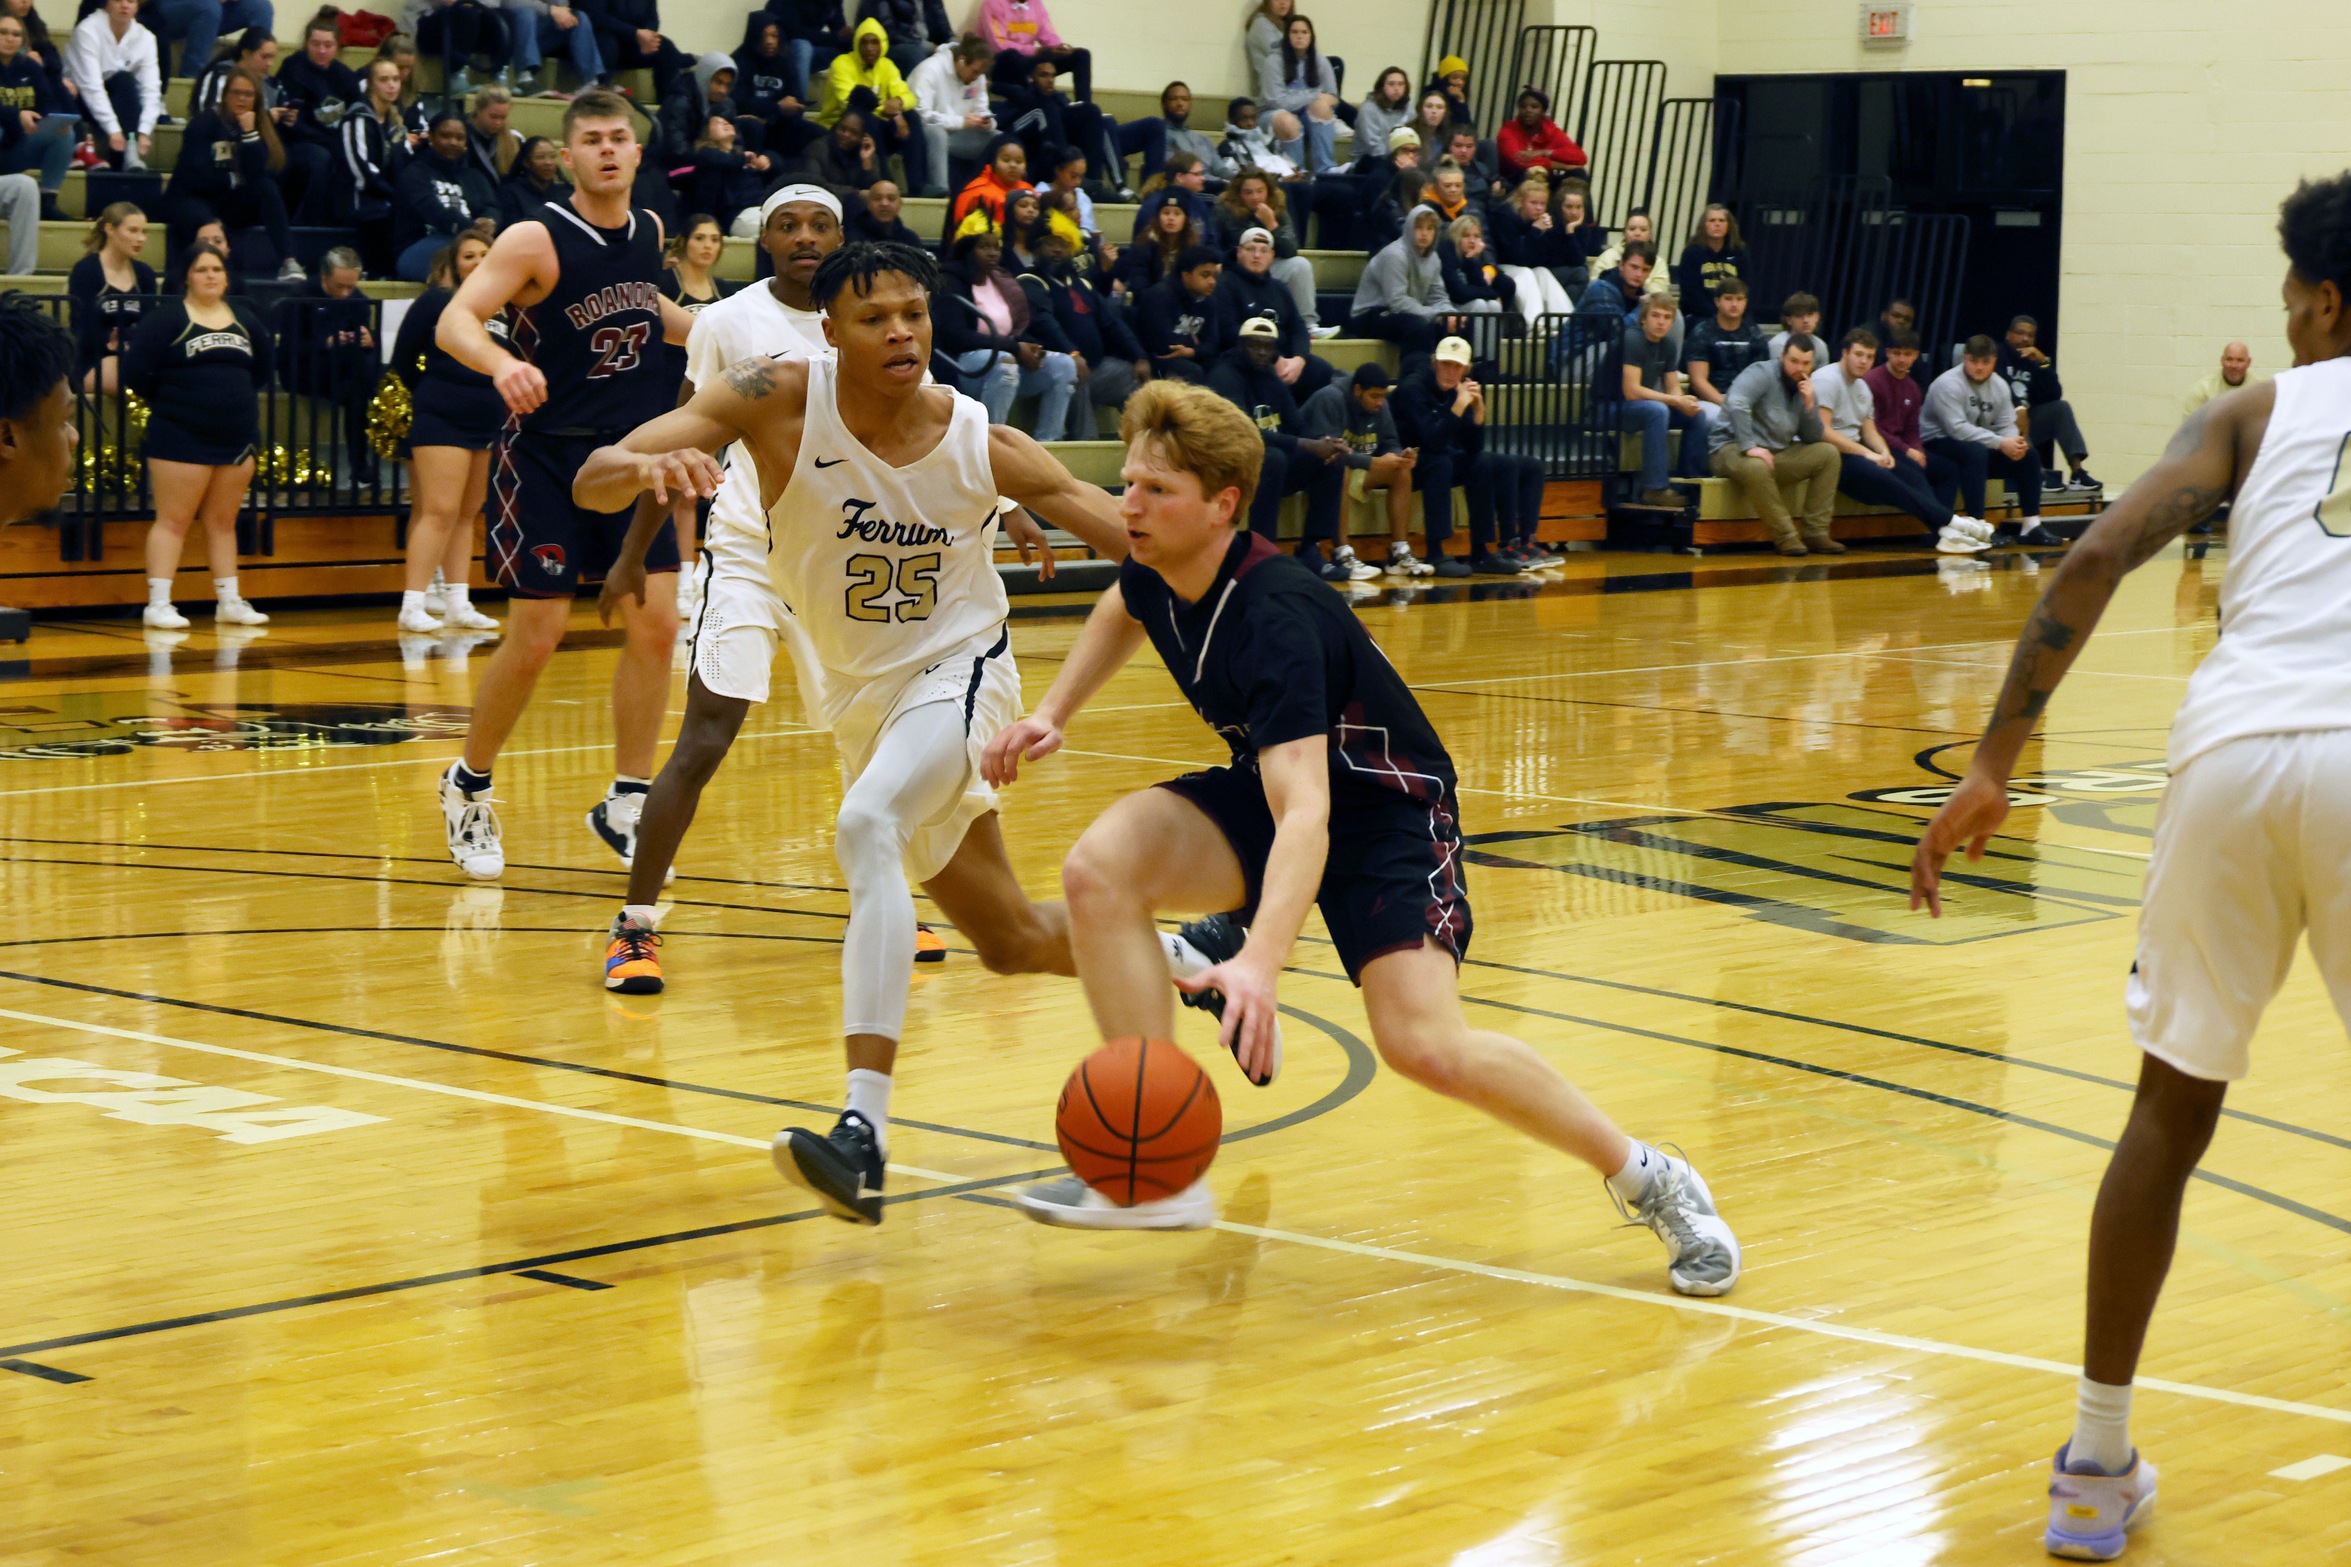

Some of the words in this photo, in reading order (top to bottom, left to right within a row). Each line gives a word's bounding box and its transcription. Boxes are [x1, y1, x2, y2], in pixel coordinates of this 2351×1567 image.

[1869, 11, 1898, 35] EXIT
[564, 281, 660, 330] ROANOK
[586, 321, 651, 379] 23
[836, 498, 955, 547] Ferrum
[845, 552, 941, 623] 25
[0, 1045, 393, 1145] CAA
